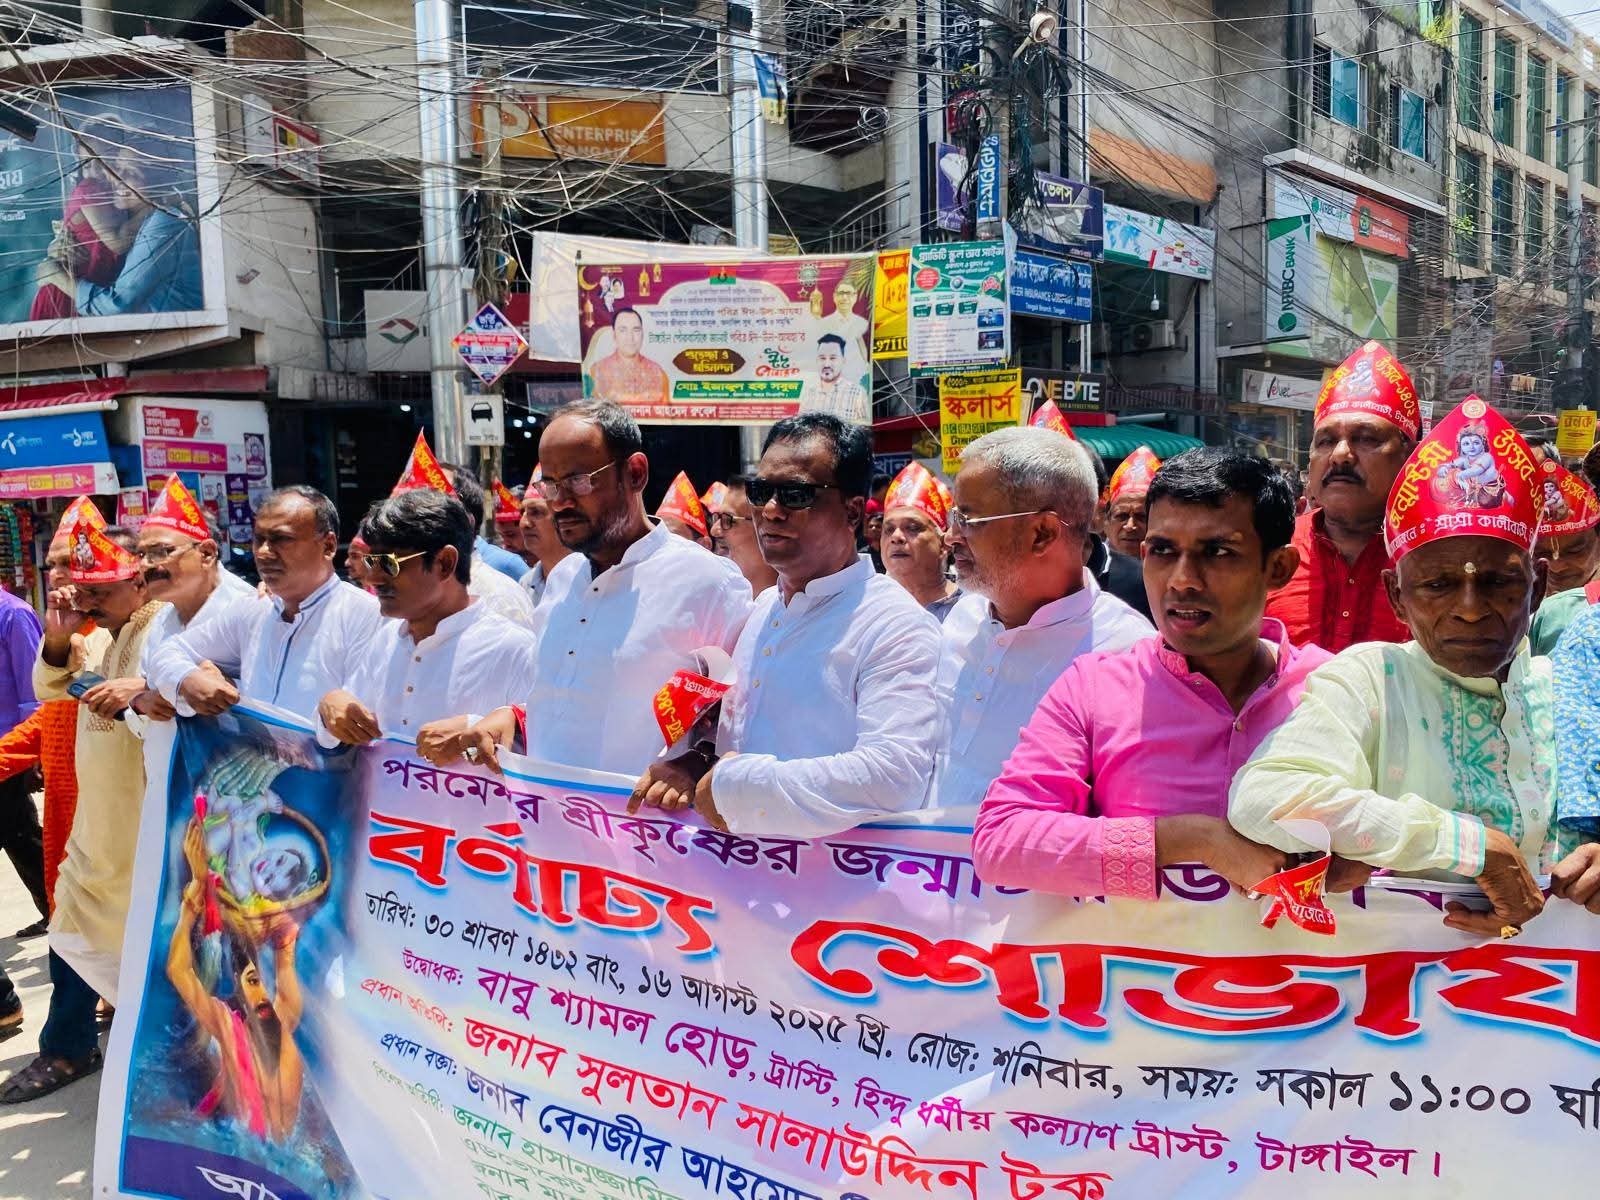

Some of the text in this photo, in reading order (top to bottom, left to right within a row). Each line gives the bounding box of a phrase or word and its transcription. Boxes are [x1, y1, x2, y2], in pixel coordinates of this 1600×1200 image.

[1282, 236, 1296, 312] NRBC BANK
[1389, 440, 1453, 529] জন্মাষ্টমী
[369, 811, 713, 952] বর্ণাঢ্য
[558, 796, 809, 874] শ্রীকৃষ্ণের
[365, 890, 416, 928] তারিখ:
[424, 914, 454, 938] ৩০
[461, 920, 519, 957] শ্রাবণ
[523, 936, 577, 981] ১৪৩২
[586, 953, 625, 995] বাং,
[638, 965, 672, 998] ১৬
[680, 974, 758, 1016] আগস্ট
[769, 1000, 847, 1044] ২০২৫
[854, 1013, 892, 1061] খ্রি.
[907, 1032, 979, 1074] রোজ:
[992, 1040, 1123, 1099] শনিবার,
[1138, 1065, 1239, 1099] সময়:
[1256, 1067, 1374, 1111] সকাল
[1389, 1070, 1532, 1115] ১১:০০
[402, 946, 463, 985] উদ্বোধক:
[478, 966, 540, 1021] বাবু
[547, 986, 657, 1045] শ্যামল
[665, 1022, 758, 1082] হোড়,
[763, 1050, 839, 1107] ট্রাস্টি,
[854, 1077, 912, 1128] হিন্দু
[917, 1096, 996, 1133] ধর্মীয়
[1004, 1111, 1124, 1151] কল্যাণ
[1129, 1120, 1239, 1175] ট্রাস্ট,
[1255, 1131, 1418, 1179] টাঙ্গাইল
[381, 1032, 422, 1061] প্রধান
[464, 1066, 530, 1122] জনাব
[539, 1104, 673, 1173] বেনজীর
[452, 1104, 516, 1150] জনাব
[464, 1017, 568, 1079] জনাব
[576, 1053, 728, 1131] সুলতান
[735, 1102, 988, 1200] সালাউদ্দিন
